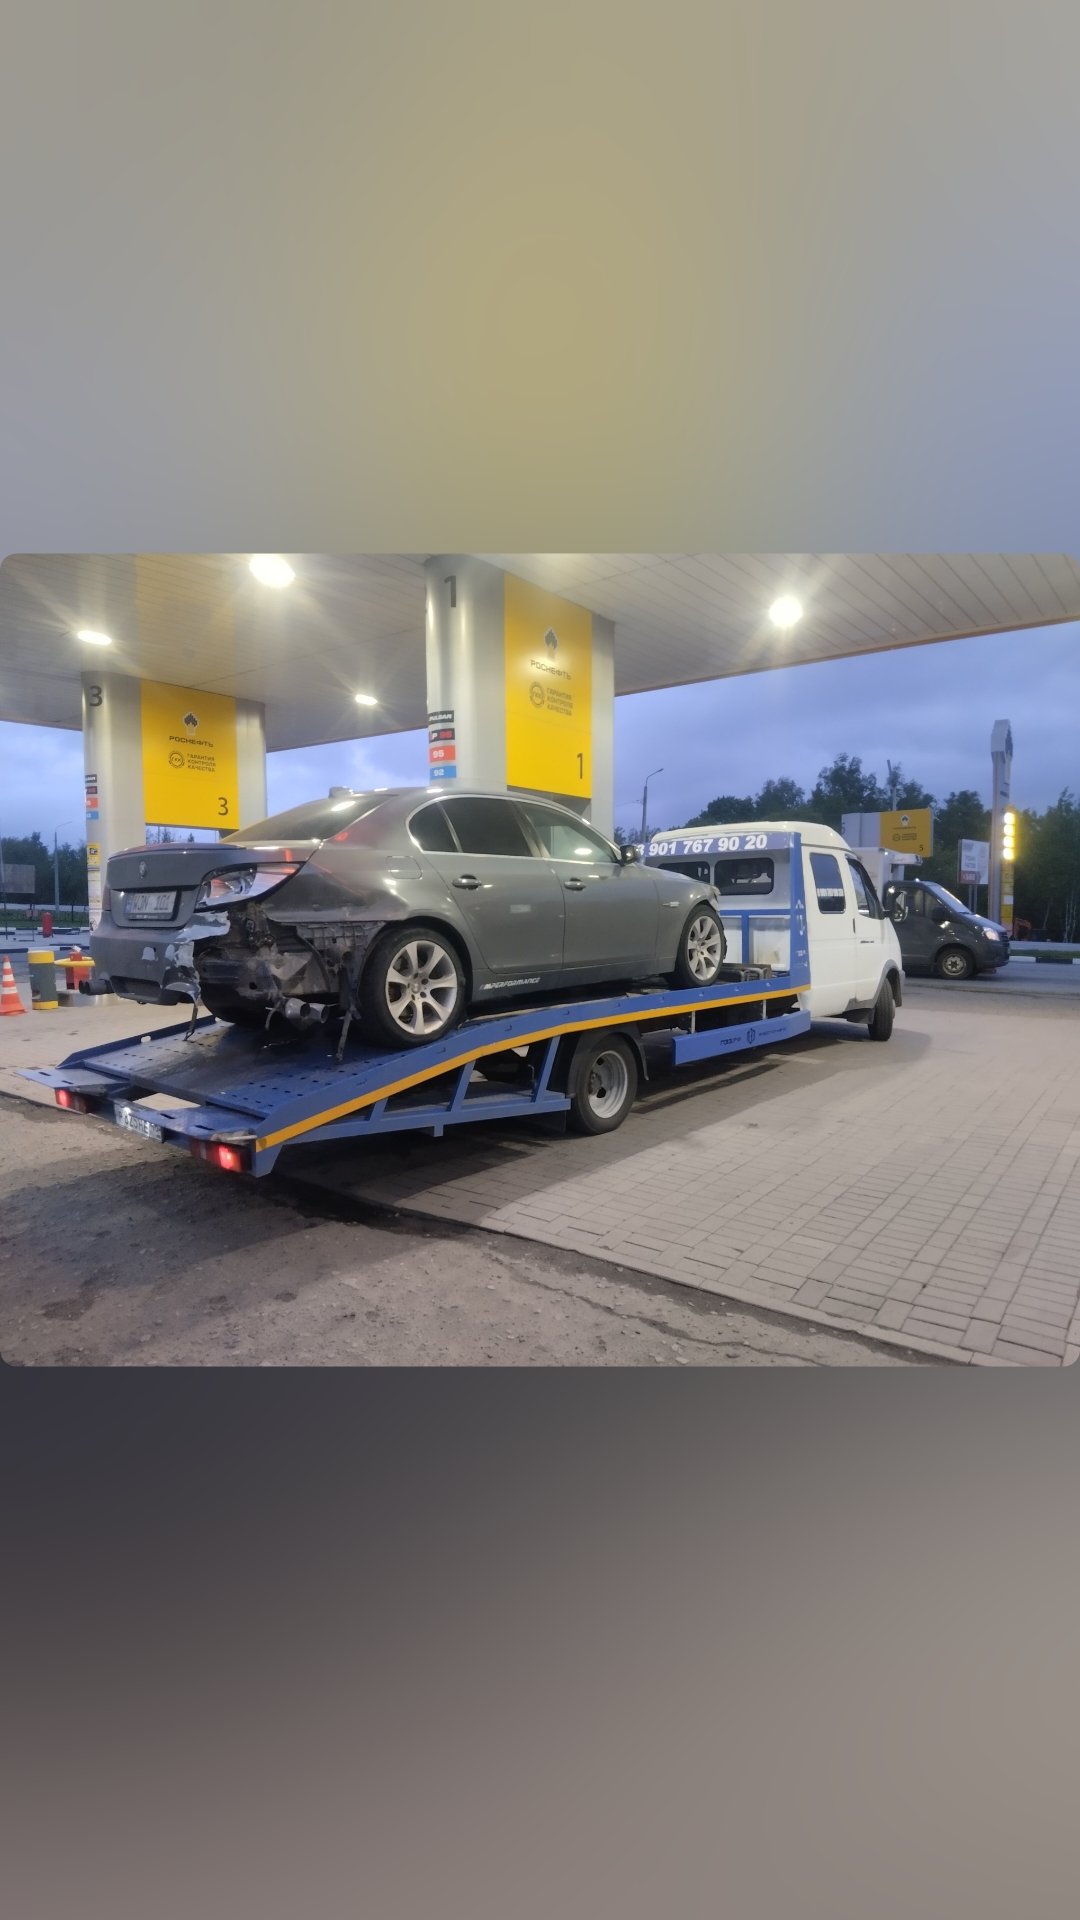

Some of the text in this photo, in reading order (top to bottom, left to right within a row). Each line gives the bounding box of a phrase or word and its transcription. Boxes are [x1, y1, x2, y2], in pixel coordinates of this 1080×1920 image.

[443, 575, 457, 608] 1
[530, 659, 573, 681] РОСНЕФТЬ
[89, 685, 103, 707] 3
[169, 735, 214, 748] РОСНЕФТЬ
[187, 753, 215, 762] ГАРАНТИЯ
[432, 749, 445, 759] 95
[187, 760, 217, 768] КОНТРОЛЯ
[187, 765, 216, 773] КАЧЕСТВА
[576, 752, 584, 780] 1
[433, 768, 445, 777] 92
[218, 796, 229, 816] 3
[648, 841, 677, 856] 901
[683, 838, 714, 854] 767
[718, 836, 740, 851] 90
[744, 834, 768, 850] 20
